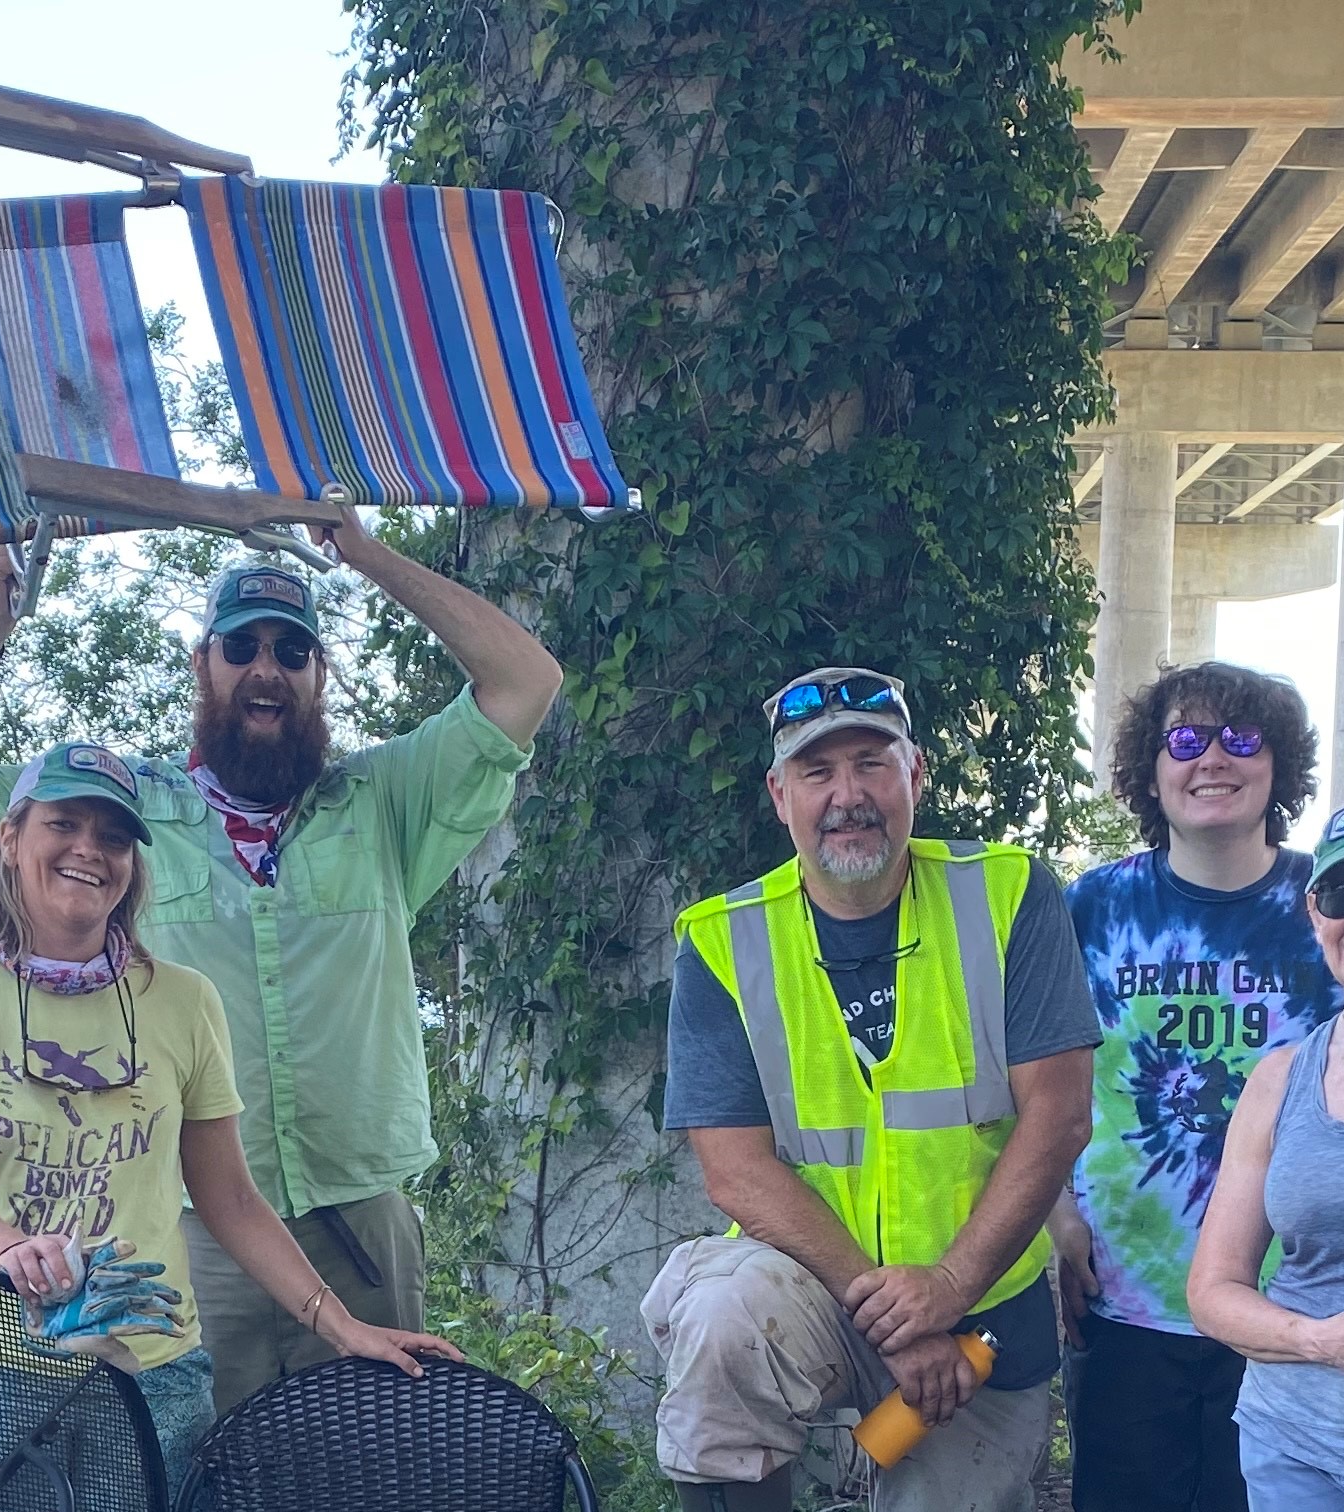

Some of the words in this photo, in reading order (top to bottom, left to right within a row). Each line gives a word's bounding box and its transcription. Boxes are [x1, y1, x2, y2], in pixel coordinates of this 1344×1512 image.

[1115, 961, 1221, 1000] BRAIN
[1232, 960, 1316, 994] GAI
[1157, 1003, 1269, 1050] 2019
[23, 1164, 113, 1199] BOMB
[8, 1196, 115, 1240] SQUAD
